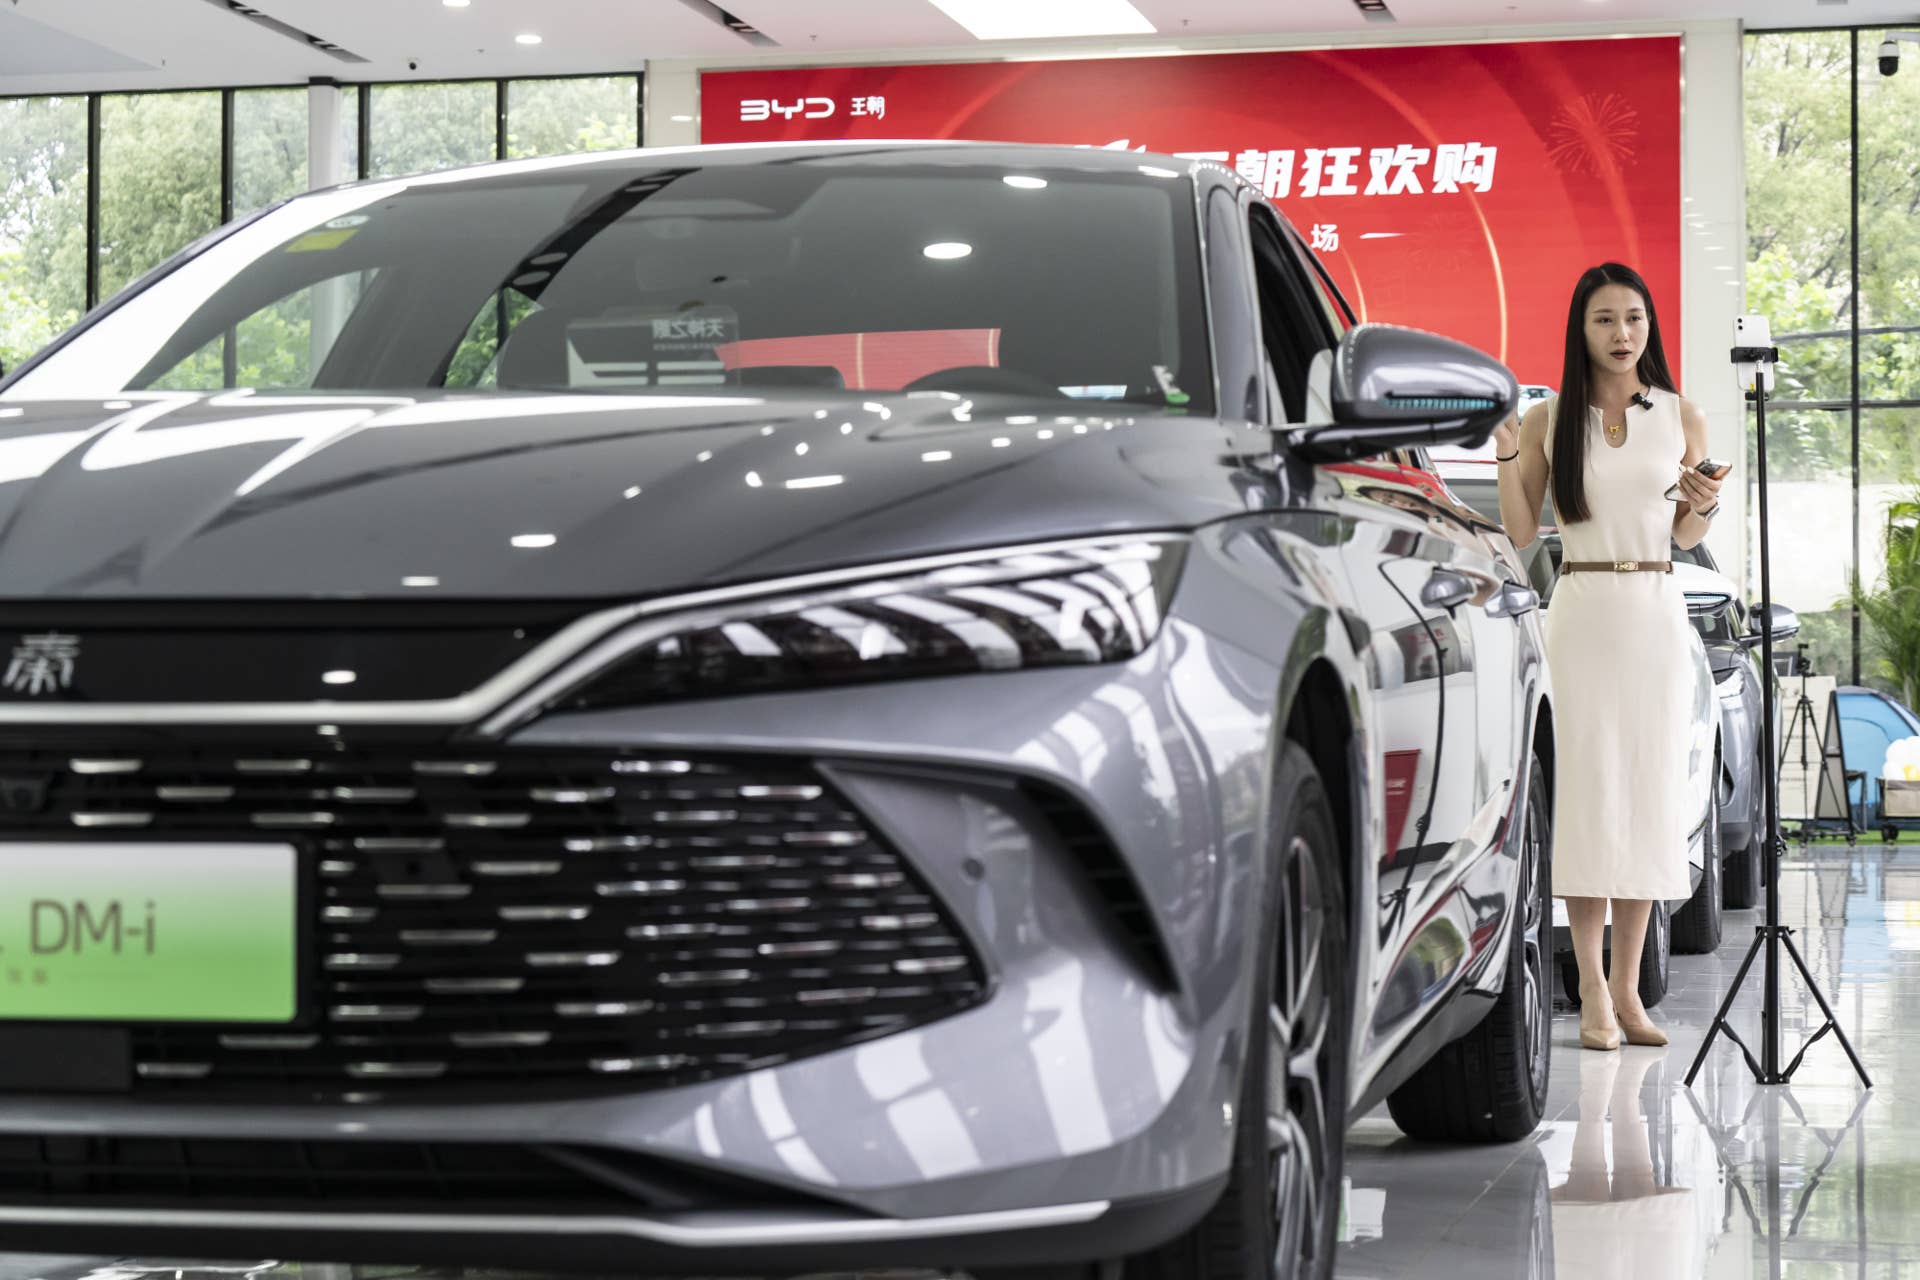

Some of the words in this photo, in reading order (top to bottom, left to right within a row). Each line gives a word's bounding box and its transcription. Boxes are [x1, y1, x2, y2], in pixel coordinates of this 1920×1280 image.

[740, 97, 836, 121] BYD
[850, 96, 886, 119] 王朝
[1173, 143, 1497, 198] 朝狂欢购
[1310, 223, 1339, 252] 场
[31, 899, 156, 955] DM-i
